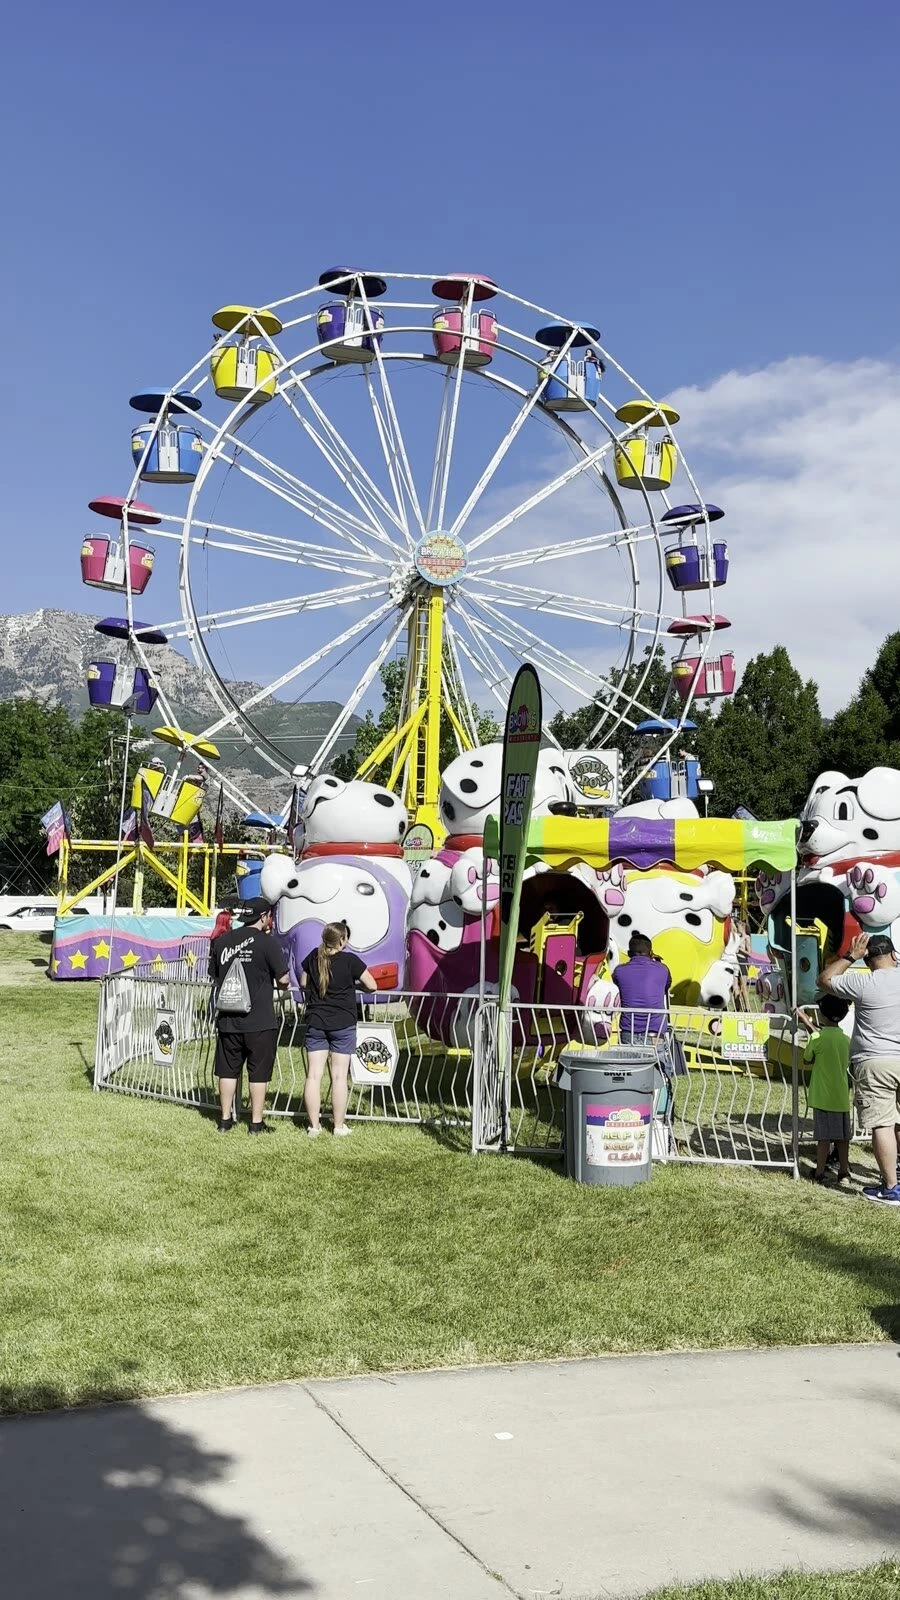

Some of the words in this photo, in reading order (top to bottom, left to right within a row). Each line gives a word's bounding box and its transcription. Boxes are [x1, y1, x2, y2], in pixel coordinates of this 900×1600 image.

[737, 1020, 754, 1041] 4
[724, 1043, 767, 1052] CREDITS
[607, 1152, 643, 1162] CLEAN
